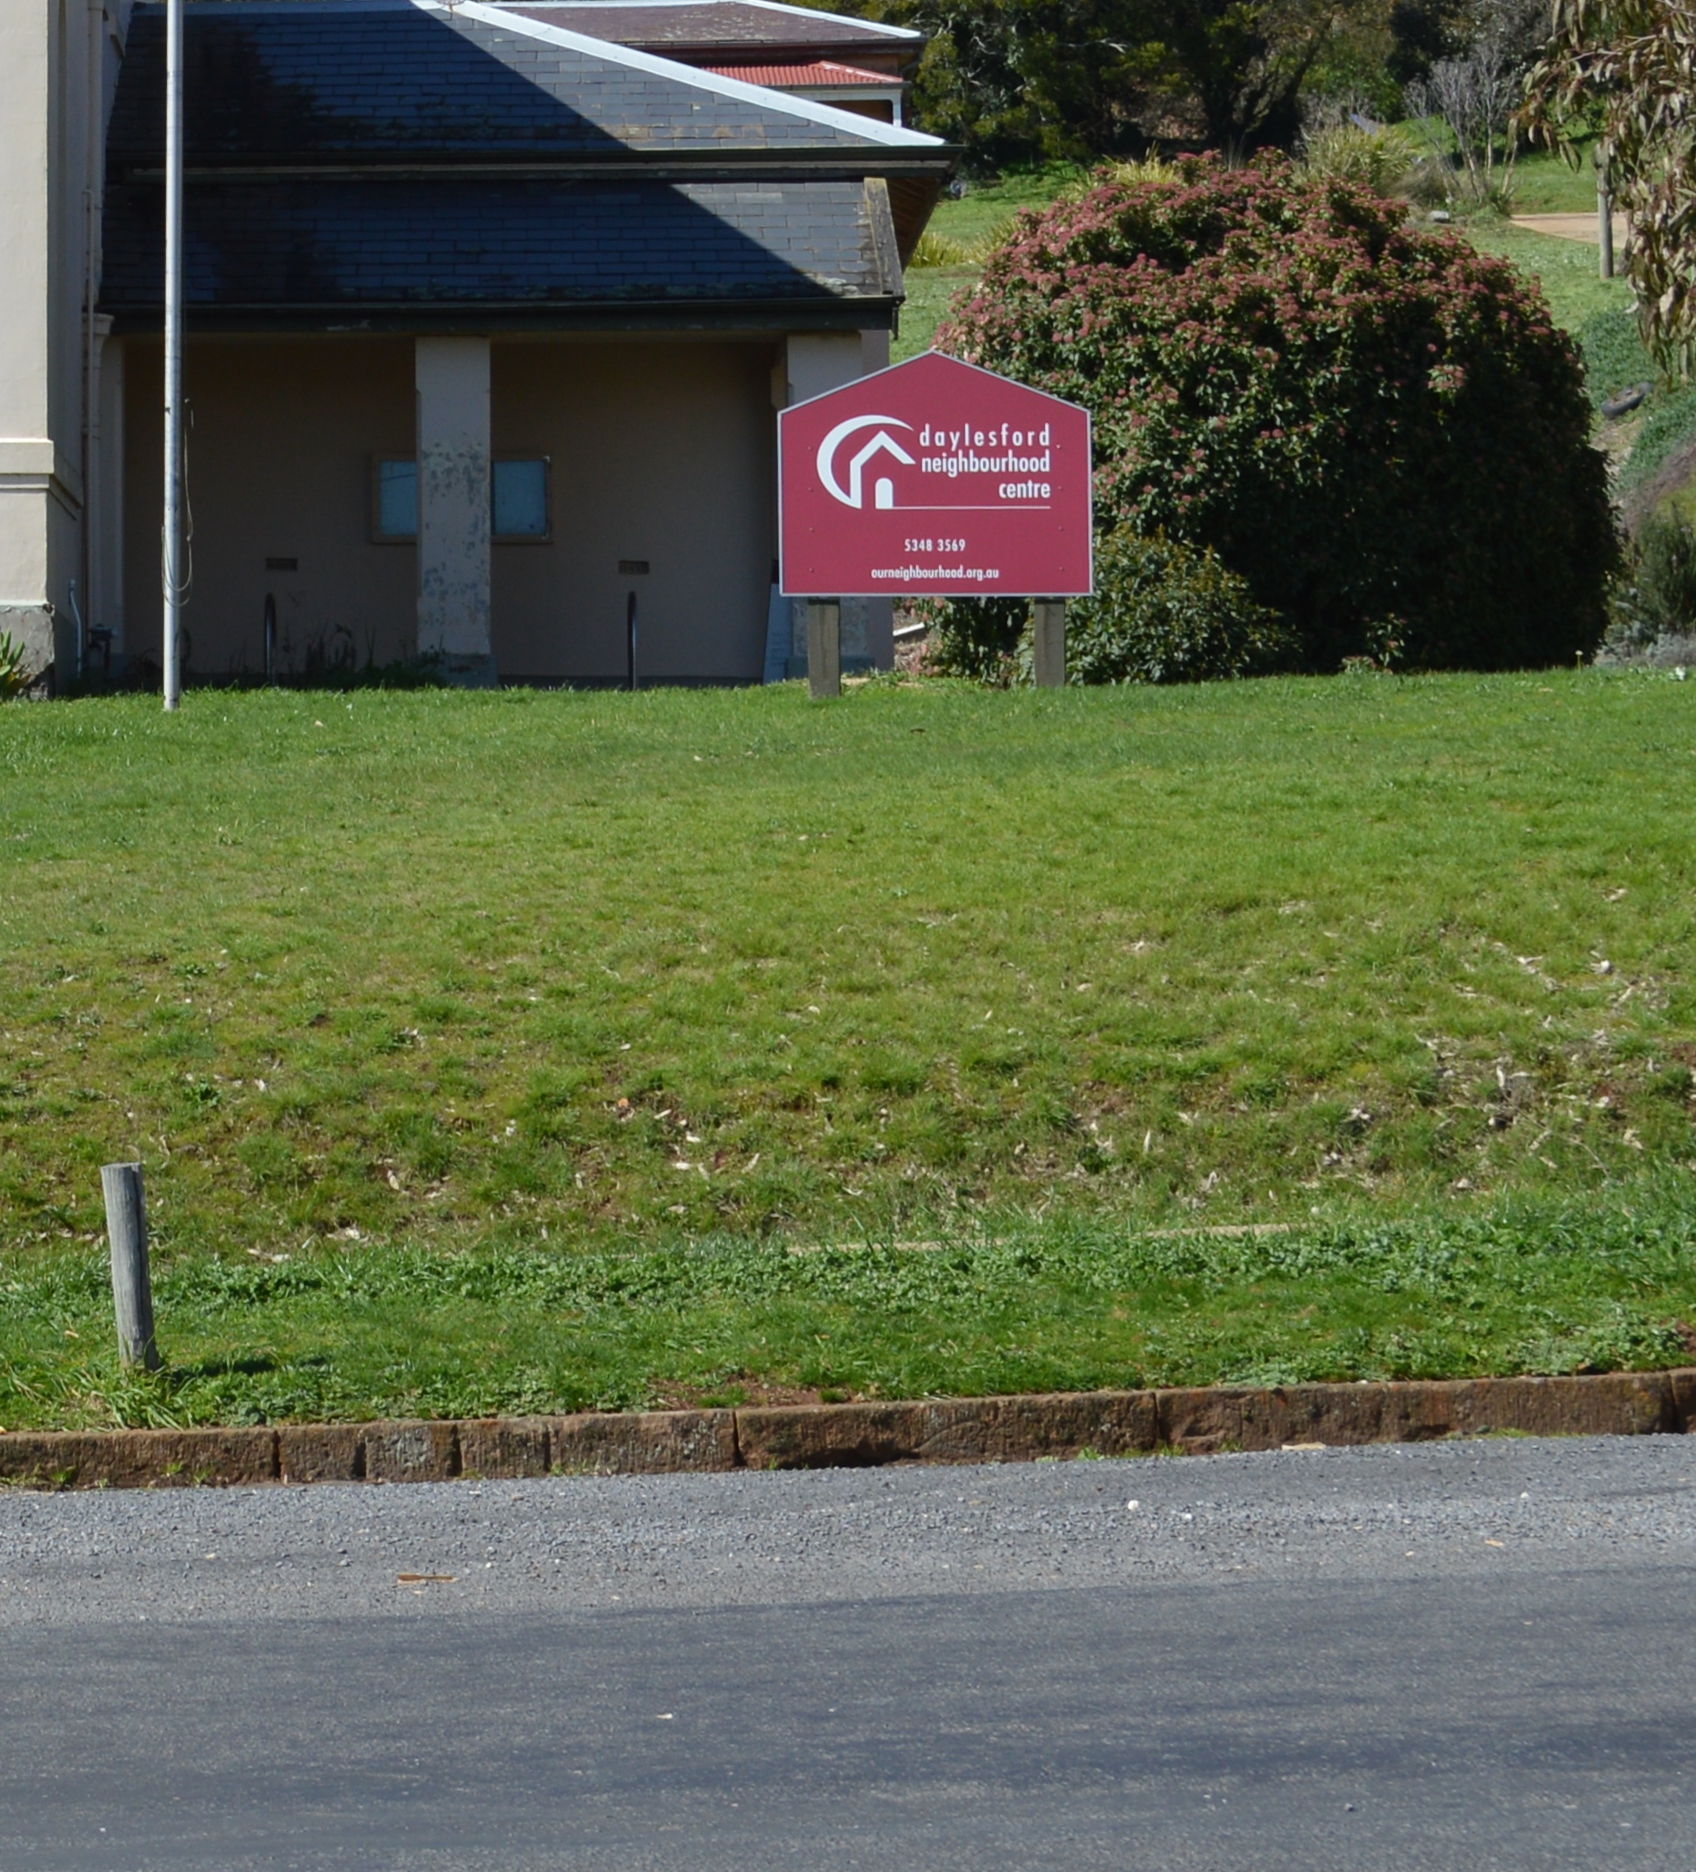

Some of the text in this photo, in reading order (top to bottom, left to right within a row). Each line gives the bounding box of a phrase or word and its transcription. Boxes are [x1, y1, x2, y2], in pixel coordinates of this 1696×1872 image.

[920, 423, 1050, 451] daylesford
[922, 450, 1050, 477] neighbourhood
[999, 480, 1050, 498] centre
[904, 538, 966, 552] 5348 3569
[871, 565, 999, 581] ourneighbourhood.org.au
